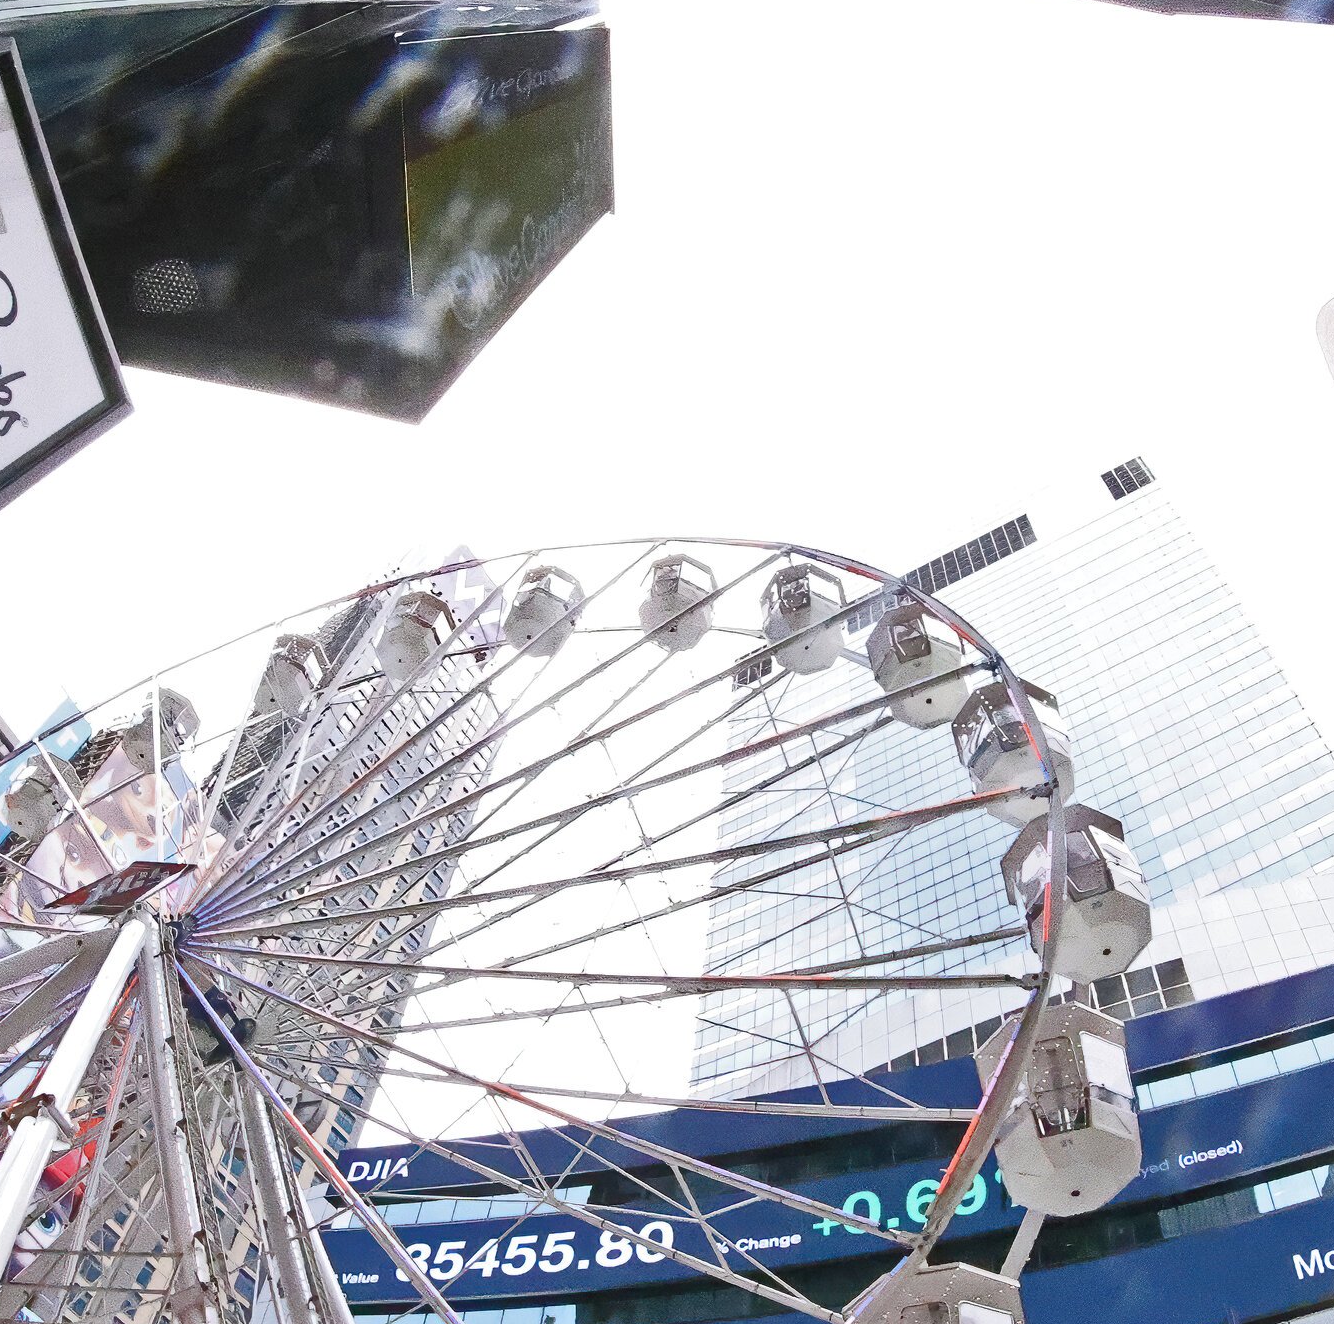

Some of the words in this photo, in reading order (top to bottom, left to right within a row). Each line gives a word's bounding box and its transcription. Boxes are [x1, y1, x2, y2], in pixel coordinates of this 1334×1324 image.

[348, 1156, 409, 1182] DJIA
[1178, 1140, 1244, 1169] (closed)
[341, 1270, 380, 1287] Value
[395, 1220, 675, 1282] 35455.80
[735, 1232, 802, 1254] Change
